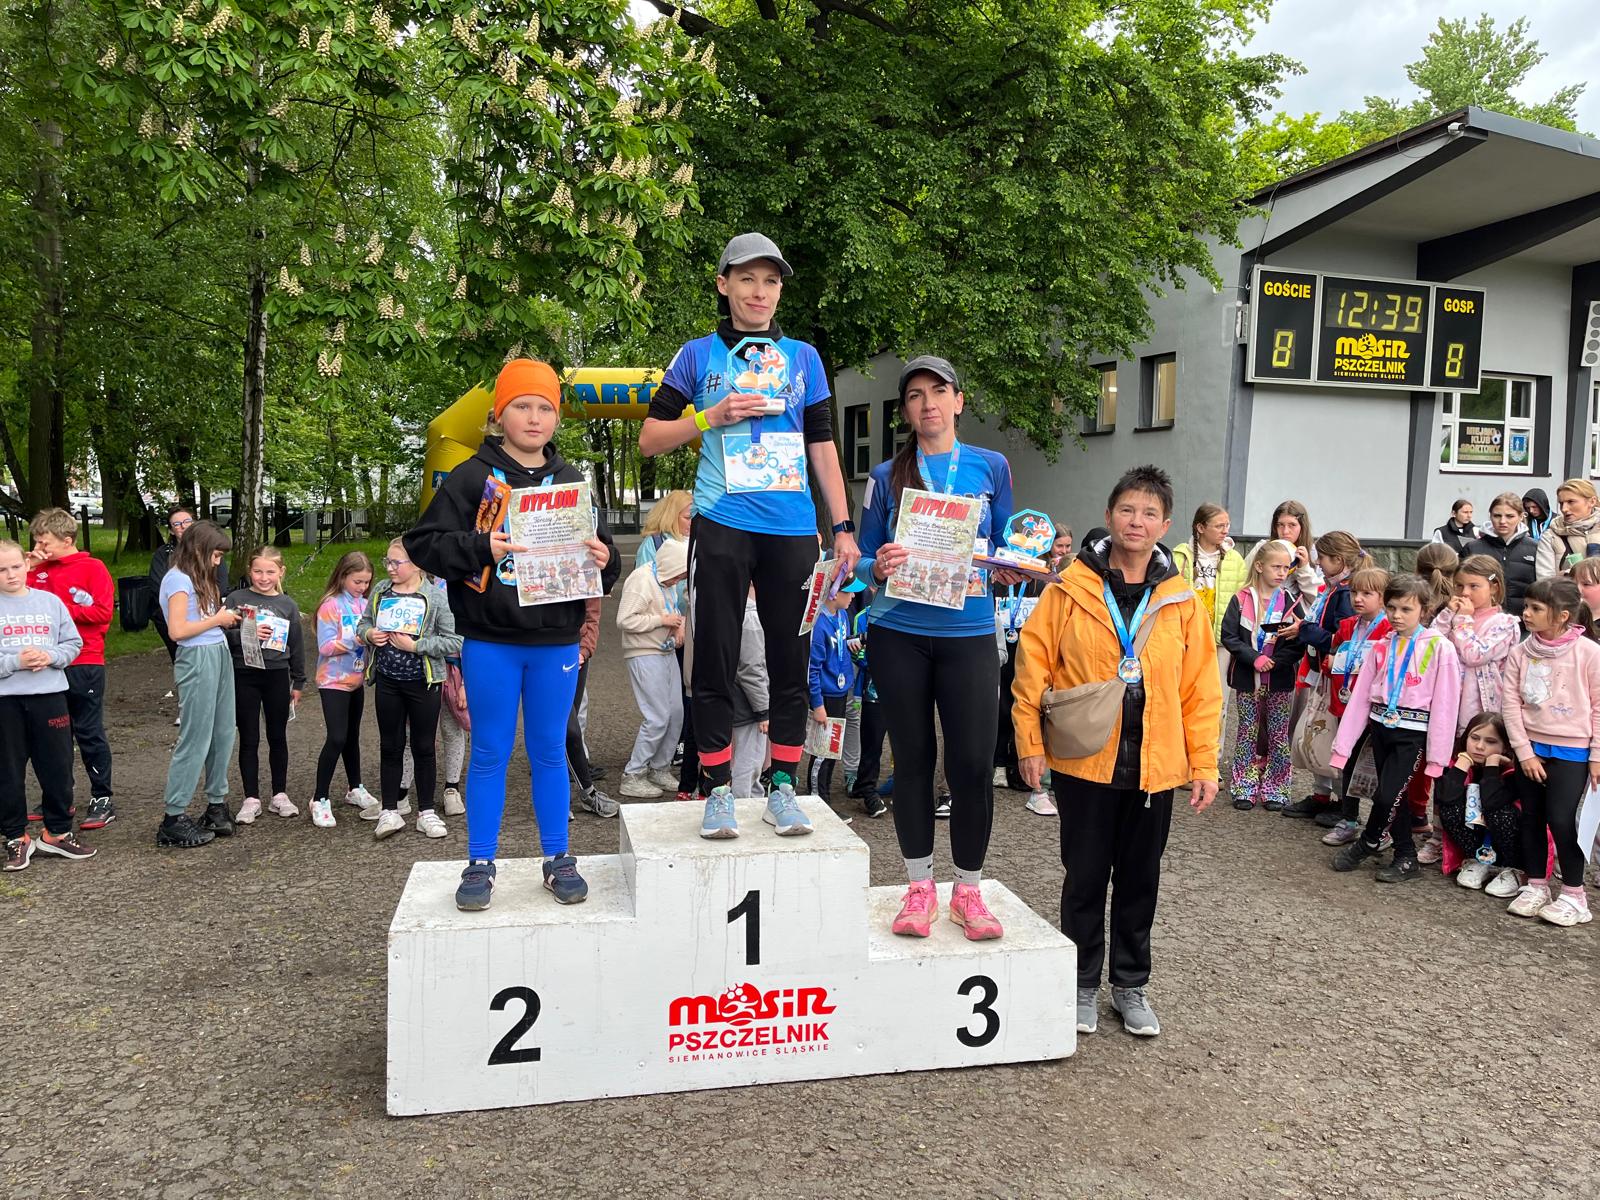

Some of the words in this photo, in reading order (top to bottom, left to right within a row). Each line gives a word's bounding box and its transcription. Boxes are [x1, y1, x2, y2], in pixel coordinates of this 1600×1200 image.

[1263, 280, 1312, 299] GOŚCIE
[1337, 291, 1422, 332] 12:39
[1443, 298, 1475, 314] GOSP.
[1334, 357, 1406, 374] PSZCZELNIK
[560, 383, 658, 404] ART
[519, 489, 579, 513] DYPLOM
[910, 496, 971, 521] DYPLOM
[0, 613, 53, 625] street
[390, 607, 411, 619] 196
[3, 624, 50, 636] dance
[0, 635, 54, 648] cademy
[727, 890, 760, 966] 1
[956, 974, 1000, 1048] 3
[488, 986, 541, 1066] 2
[669, 1022, 830, 1053] PSZCZELNIK
[668, 1048, 768, 1064] SIEMIANOWICE
